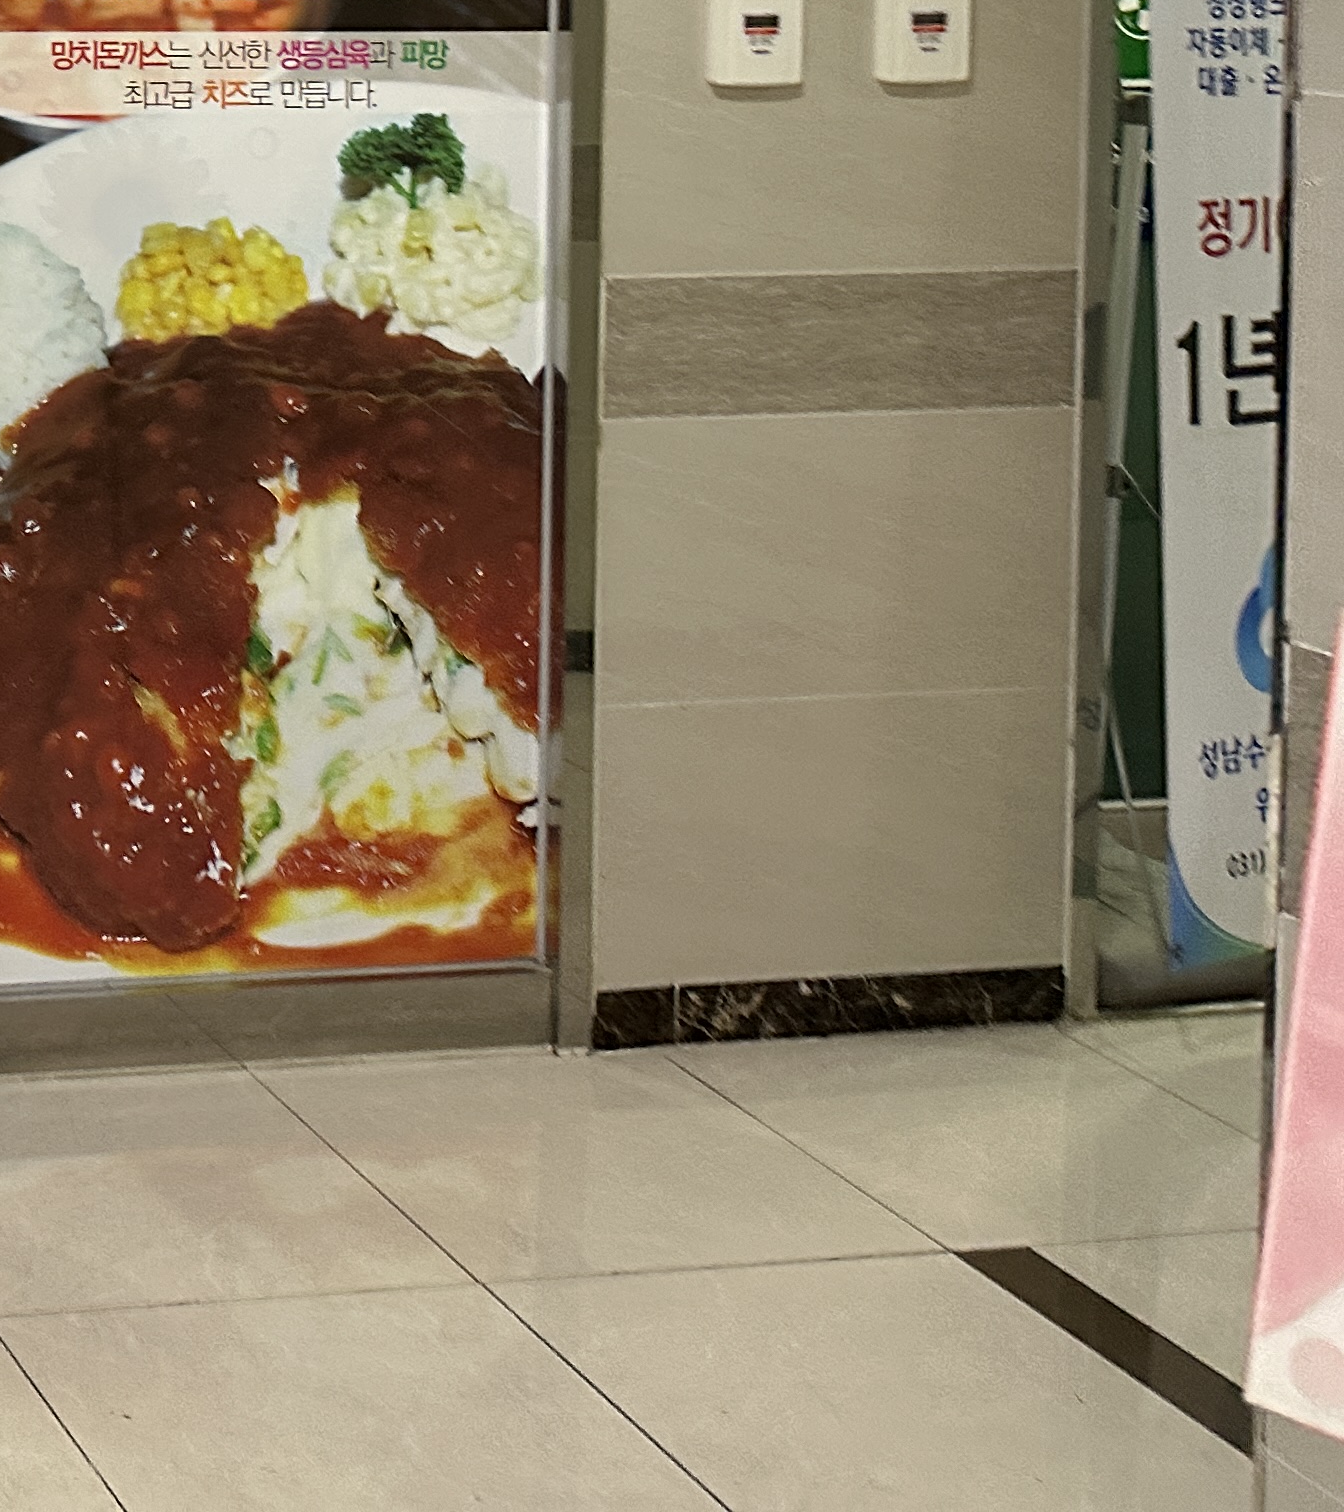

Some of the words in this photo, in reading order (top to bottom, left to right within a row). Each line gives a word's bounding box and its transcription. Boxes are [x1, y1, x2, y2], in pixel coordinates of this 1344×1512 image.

[51, 39, 192, 70] 망치돈까스는
[198, 39, 271, 70] 신선한
[276, 39, 396, 70] 생등심육과
[400, 39, 449, 70] 피망
[123, 78, 193, 110] 최고급
[202, 78, 274, 110] 치즈로
[280, 78, 378, 110] 만듭니다.
[1198, 196, 1280, 257] 정기
